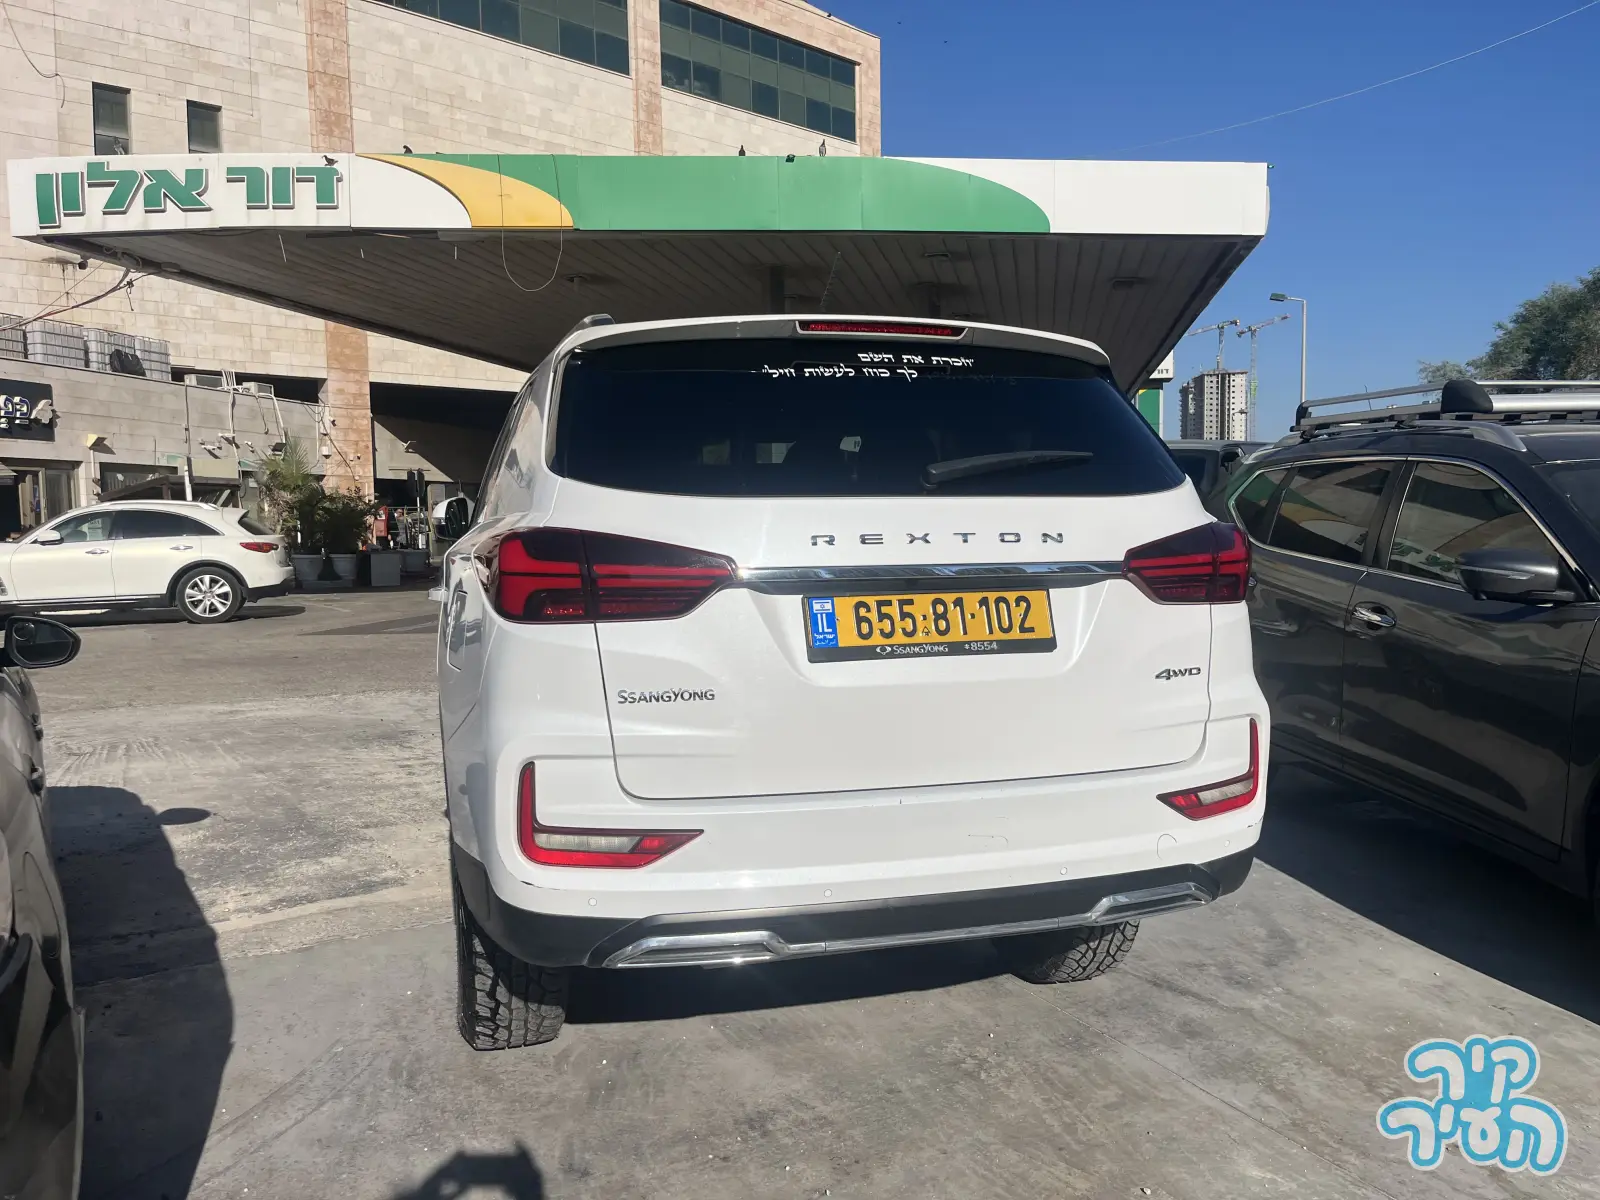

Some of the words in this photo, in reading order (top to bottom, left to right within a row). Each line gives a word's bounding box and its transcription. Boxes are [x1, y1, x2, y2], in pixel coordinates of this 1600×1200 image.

[35, 161, 213, 228] אלון
[226, 166, 343, 210] דור
[858, 352, 895, 363] השם
[902, 354, 925, 364] את
[804, 363, 855, 378] לעשות
[862, 367, 890, 377] כוח
[897, 366, 918, 382] לך
[810, 532, 1064, 547] REXTON
[817, 613, 833, 633] IL
[1155, 666, 1201, 681] 4WD
